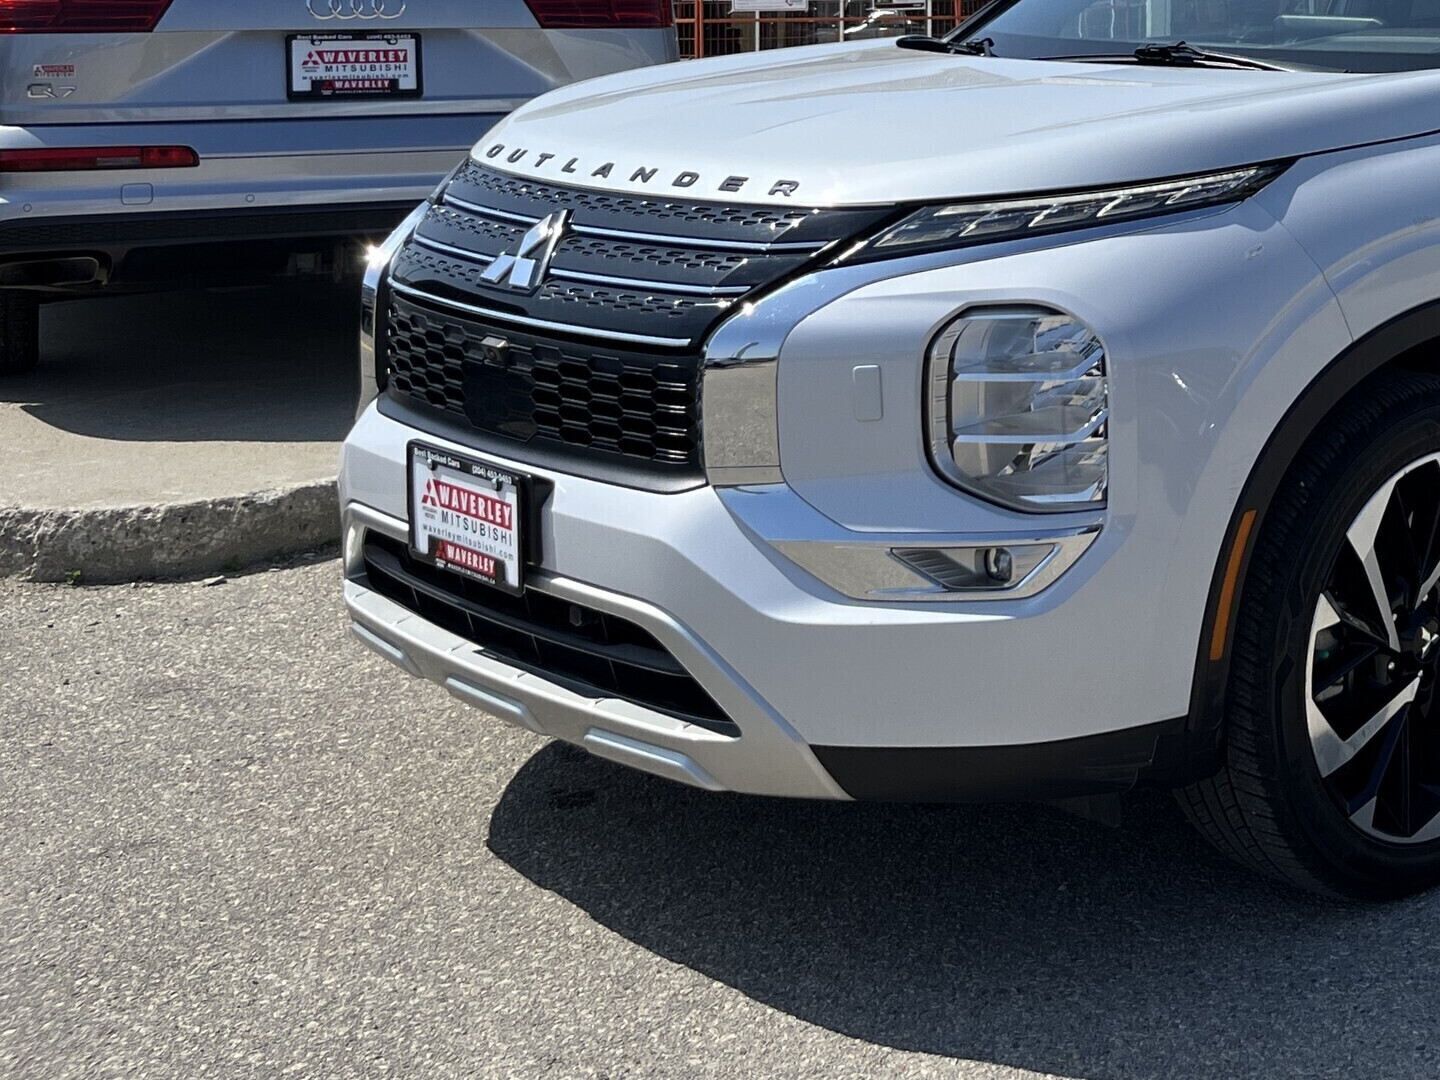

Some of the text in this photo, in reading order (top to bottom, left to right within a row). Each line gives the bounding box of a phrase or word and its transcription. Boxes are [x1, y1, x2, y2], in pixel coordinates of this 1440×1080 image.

[322, 50, 406, 63] WAVERLEY
[325, 64, 407, 72] MITSUBISHI
[27, 83, 77, 98] Q7
[335, 80, 389, 89] WAVERLEY
[485, 143, 800, 198] OUTLANDER
[439, 484, 512, 527] WAVERLEY
[422, 523, 514, 561] waverleymitsubishi.com
[441, 510, 512, 547] MITSUBISHI
[446, 544, 495, 574] WAVERLEY
